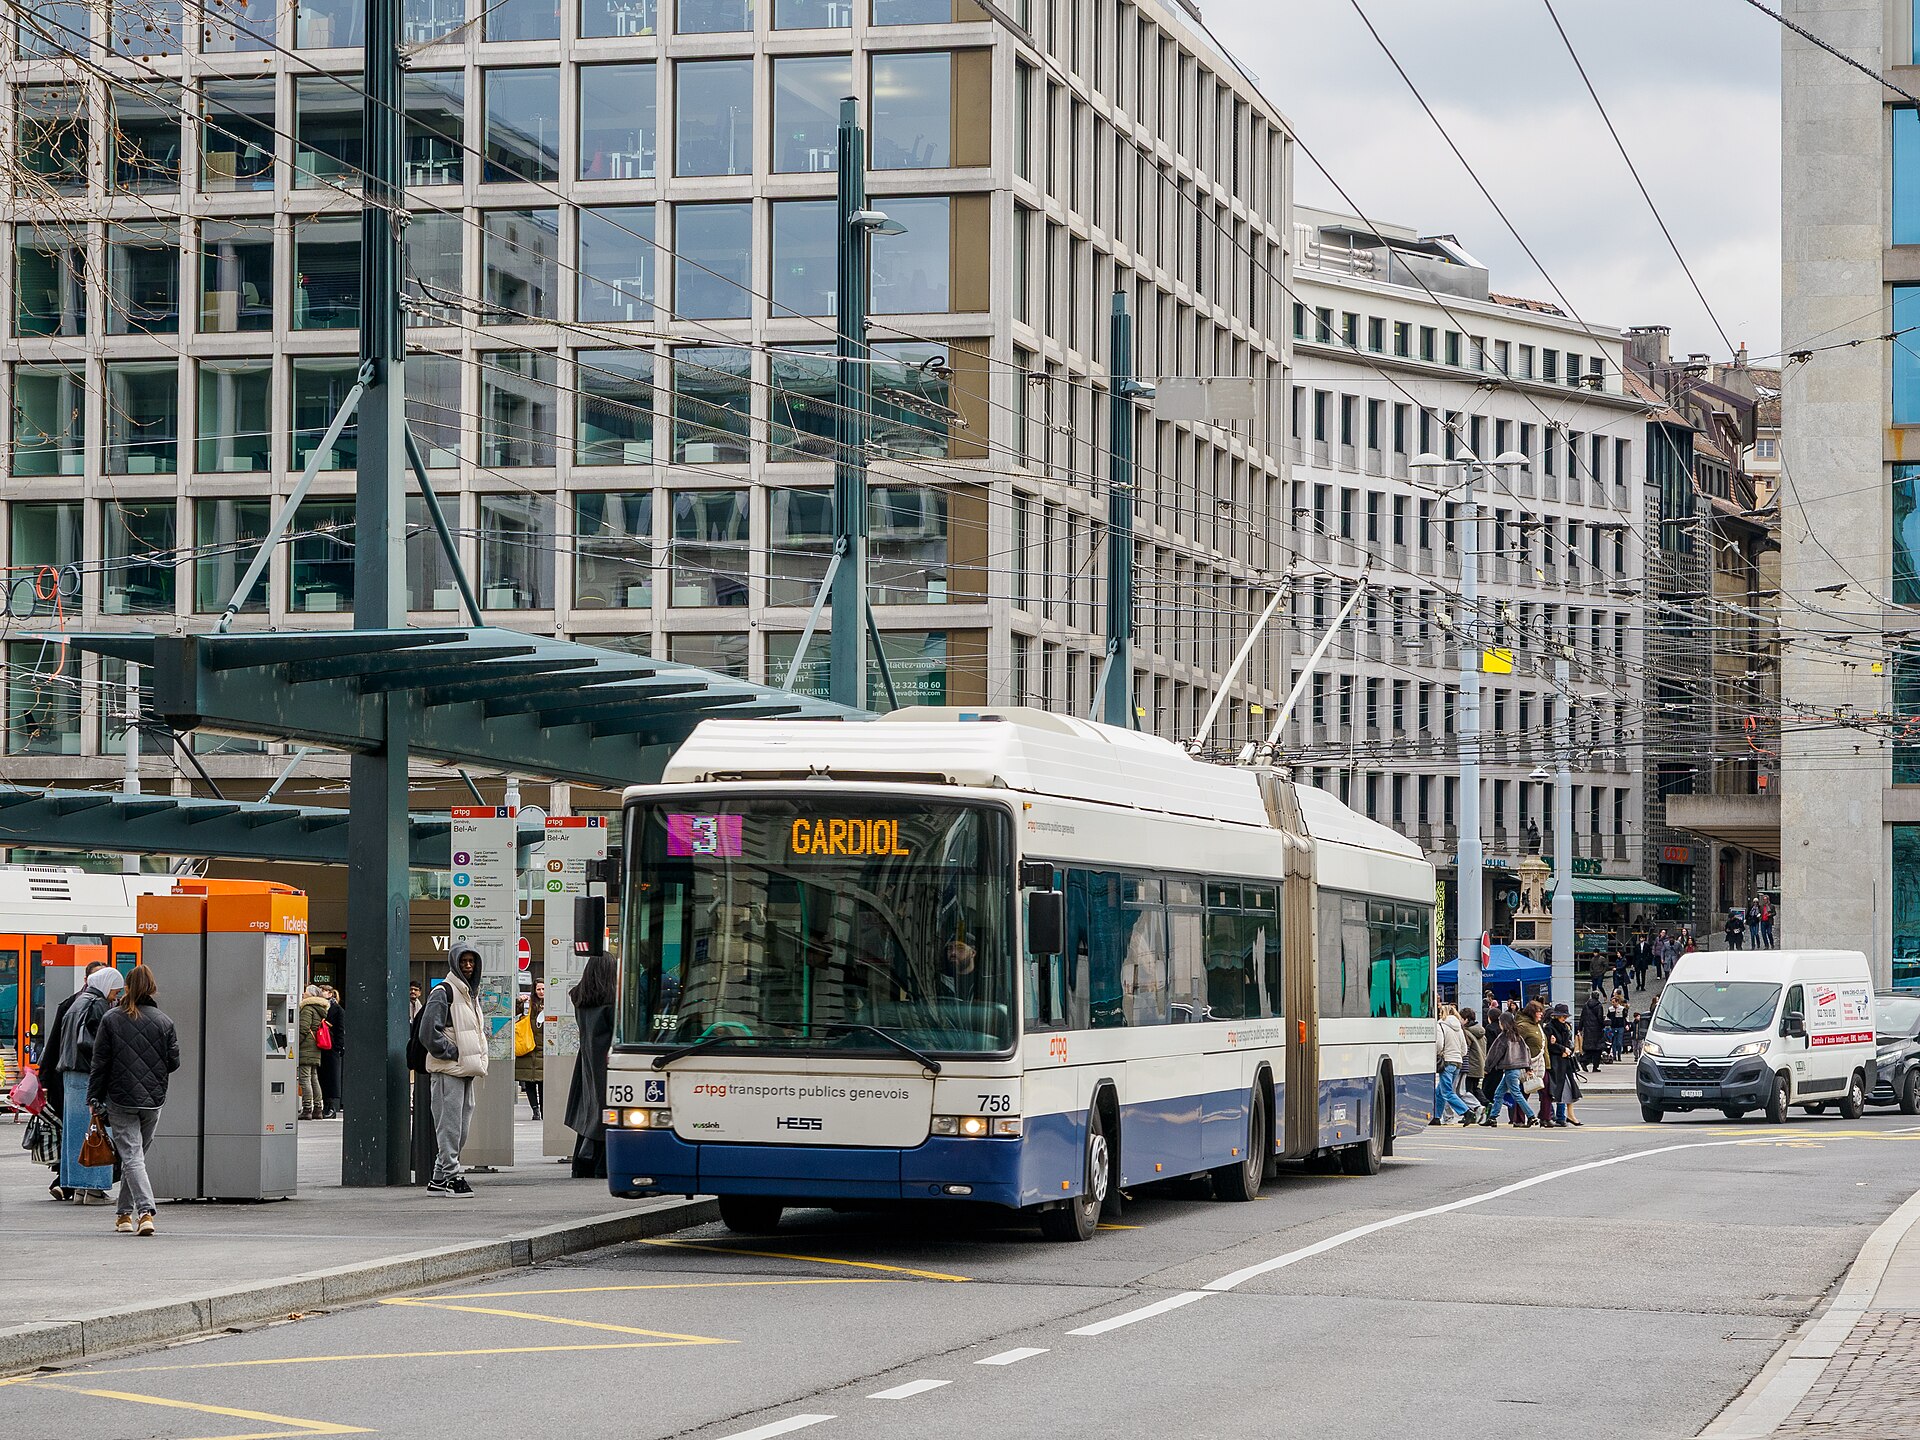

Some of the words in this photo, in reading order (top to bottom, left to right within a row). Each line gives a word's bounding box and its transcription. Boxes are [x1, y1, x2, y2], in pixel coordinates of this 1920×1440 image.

[775, 657, 783, 670] À
[787, 660, 816, 670] ler:
[872, 660, 936, 669] Ctactez-nous
[499, 809, 506, 817] C
[453, 825, 478, 833] Bel-Air
[692, 816, 718, 853] 3
[791, 818, 909, 856] GARDIOL
[458, 854, 466, 863] 3
[1663, 846, 1690, 863] coop
[549, 862, 561, 870] 19
[458, 875, 465, 884] 5
[548, 882, 561, 890] 20
[458, 896, 465, 905] 7
[282, 915, 308, 932] Tickets
[455, 917, 467, 927] 10
[608, 1085, 634, 1103] 758
[705, 1083, 727, 1098] tpg
[729, 1084, 796, 1098] transports
[798, 1086, 846, 1100] publics
[849, 1088, 909, 1101] genevois
[977, 1094, 1011, 1112] 758
[776, 1116, 823, 1131] HESS
